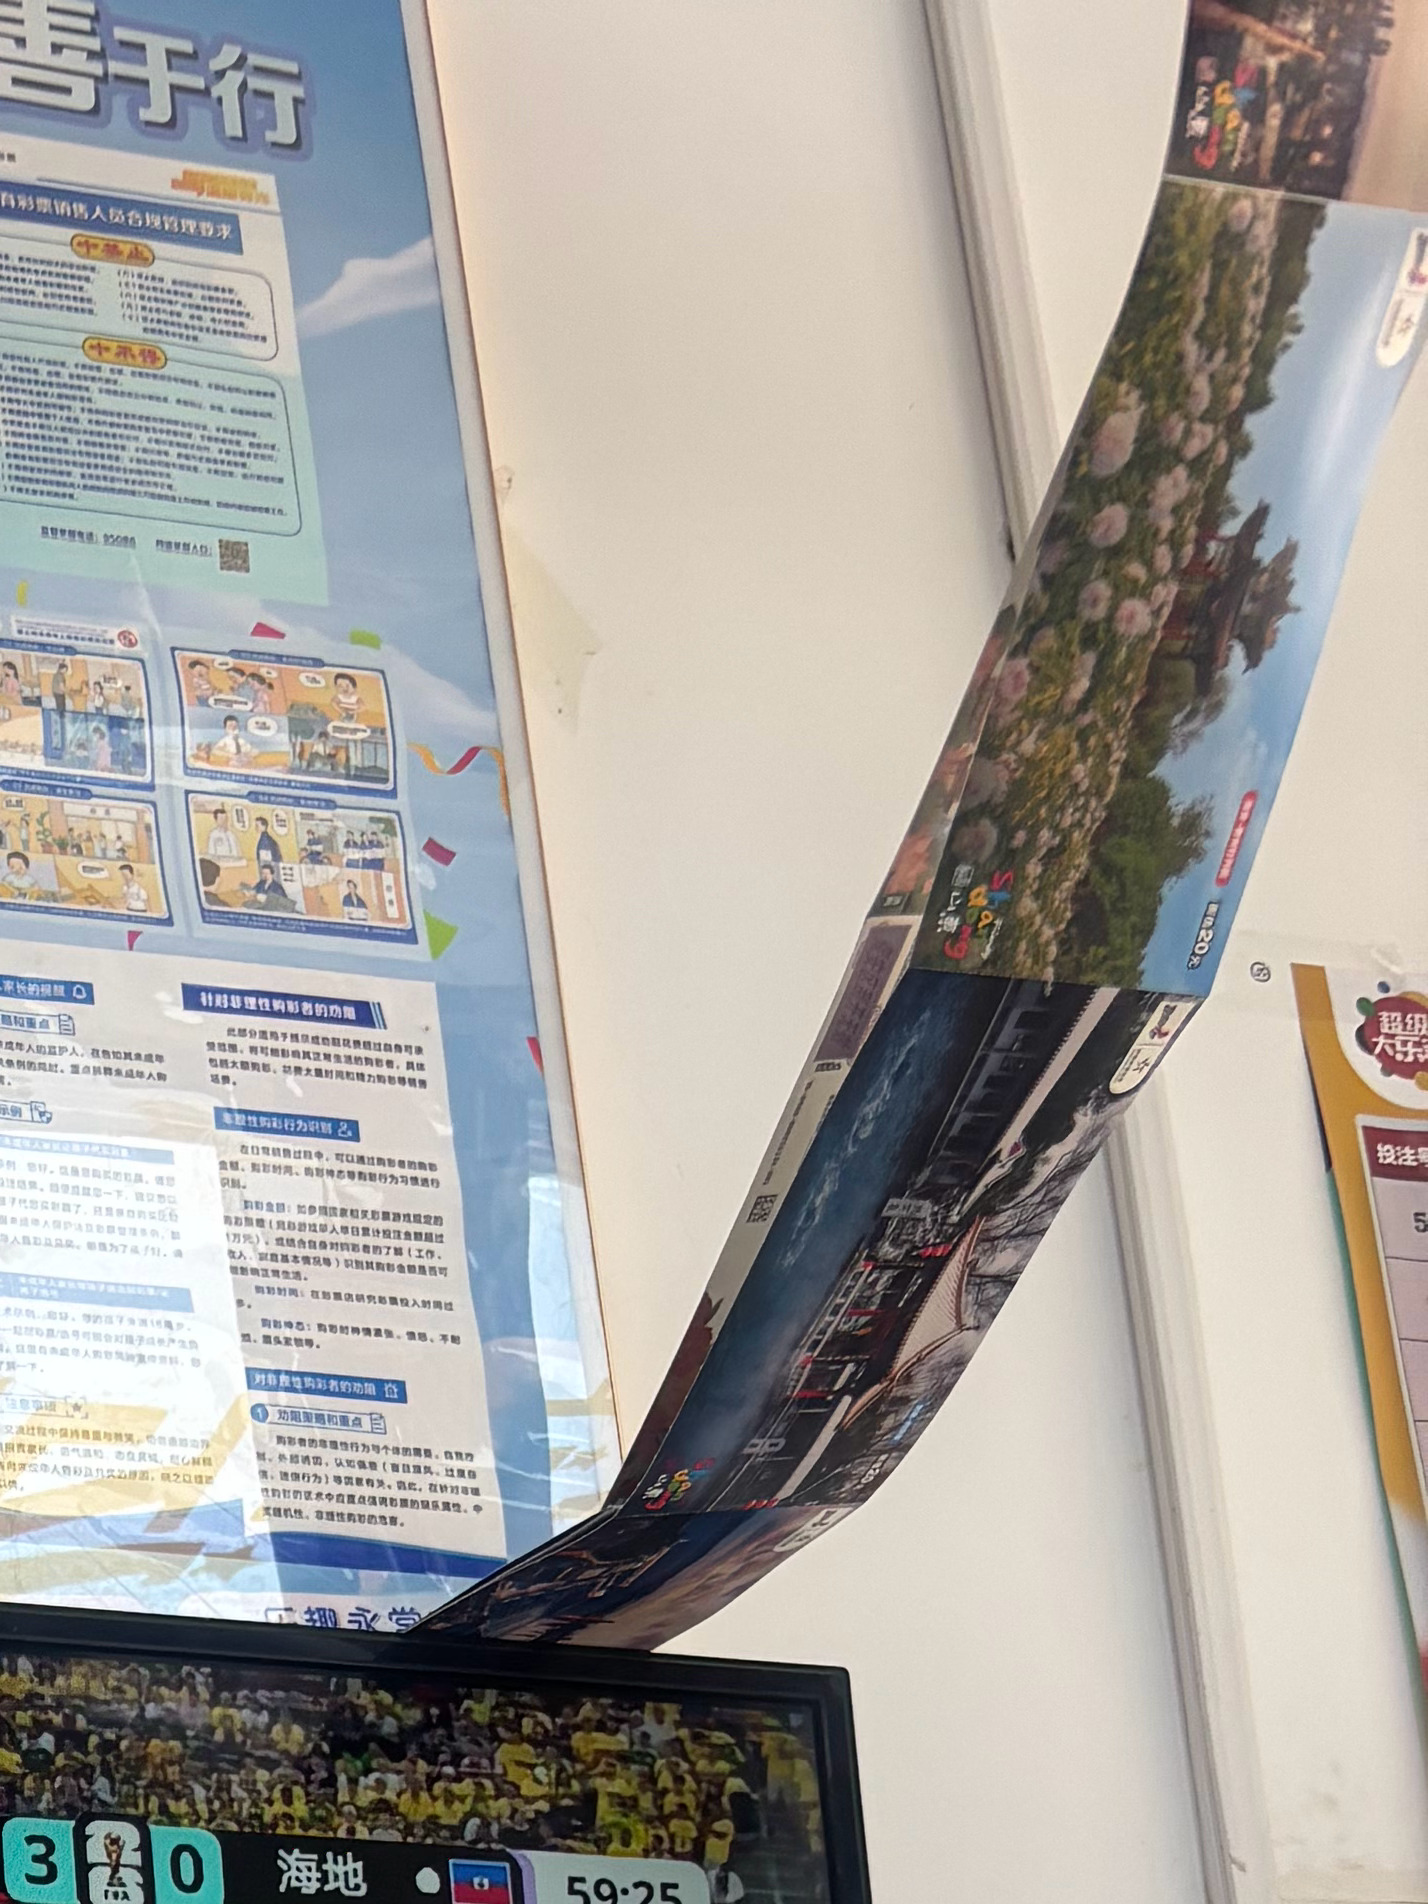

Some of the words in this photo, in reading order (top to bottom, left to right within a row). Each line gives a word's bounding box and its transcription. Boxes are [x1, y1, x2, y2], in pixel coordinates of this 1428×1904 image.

[24, 1834, 58, 1885] 3
[170, 1844, 204, 1894] 0
[277, 1850, 367, 1899] 海地
